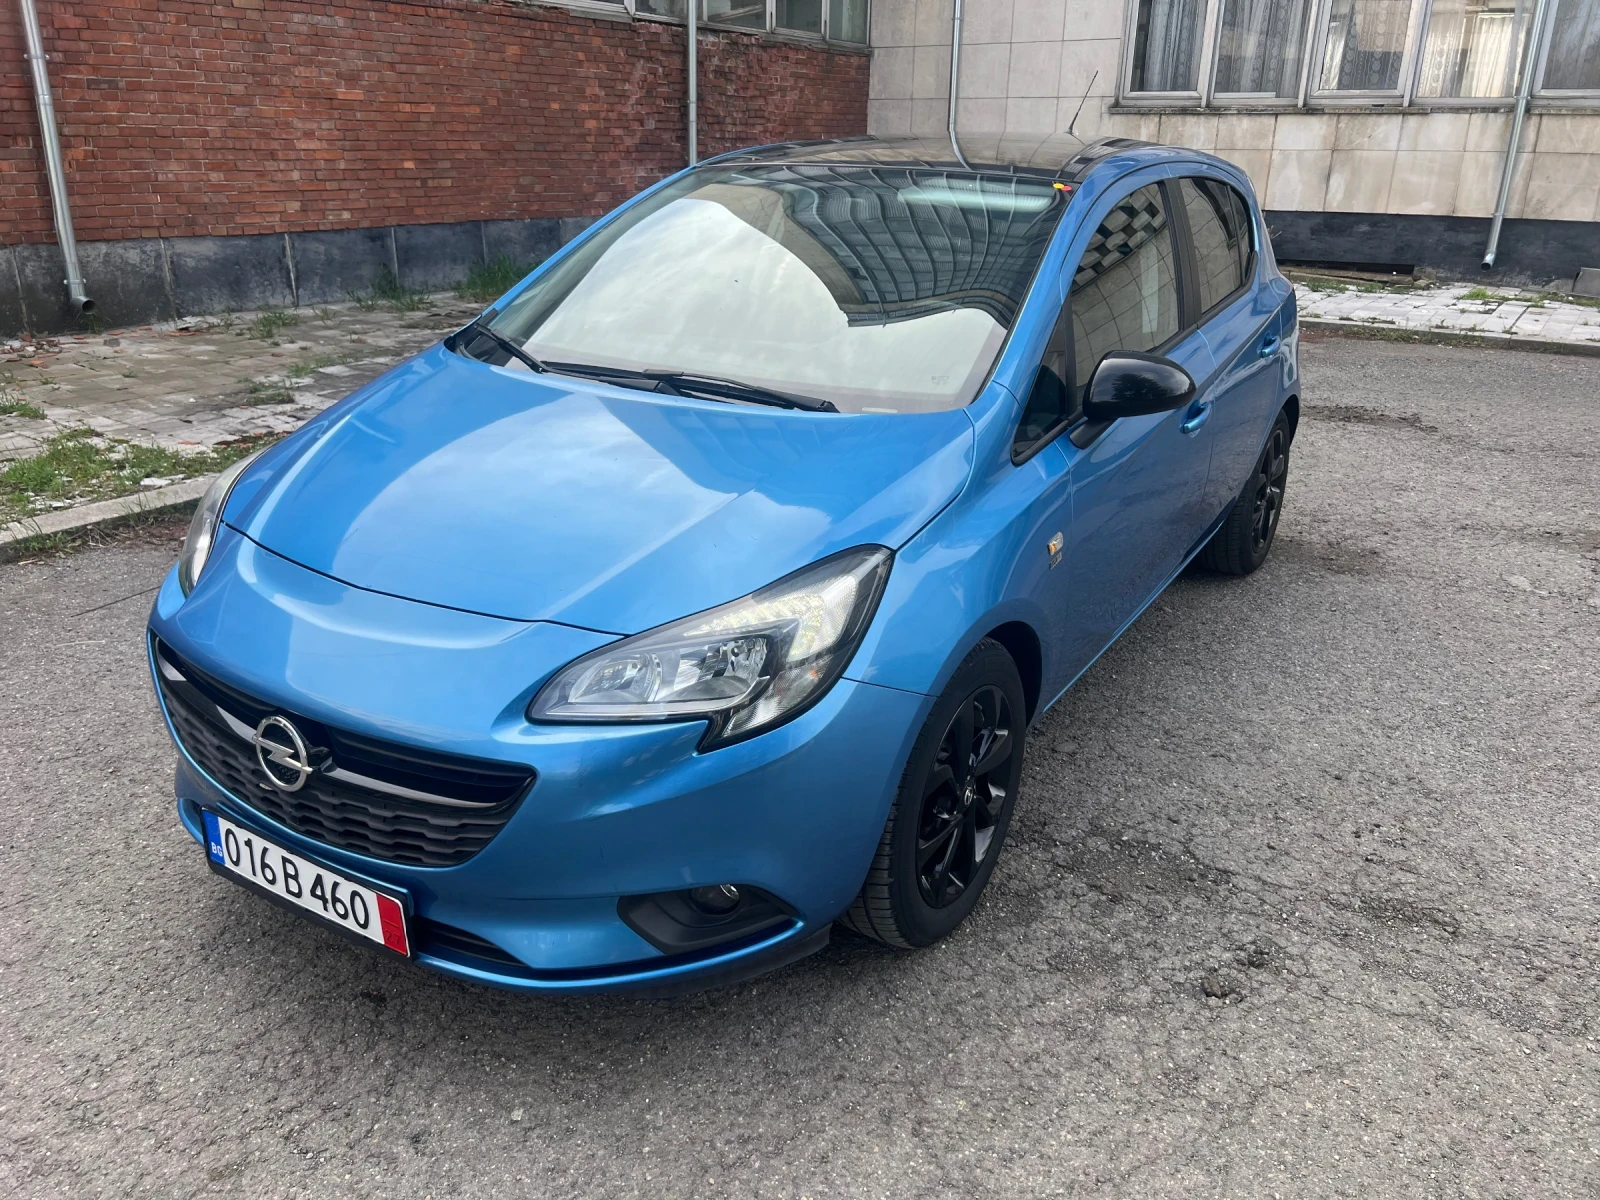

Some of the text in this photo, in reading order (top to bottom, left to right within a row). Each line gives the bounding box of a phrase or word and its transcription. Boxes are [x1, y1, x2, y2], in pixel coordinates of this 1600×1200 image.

[211, 841, 223, 857] BG
[225, 828, 276, 886] 016
[310, 873, 370, 930] 460
